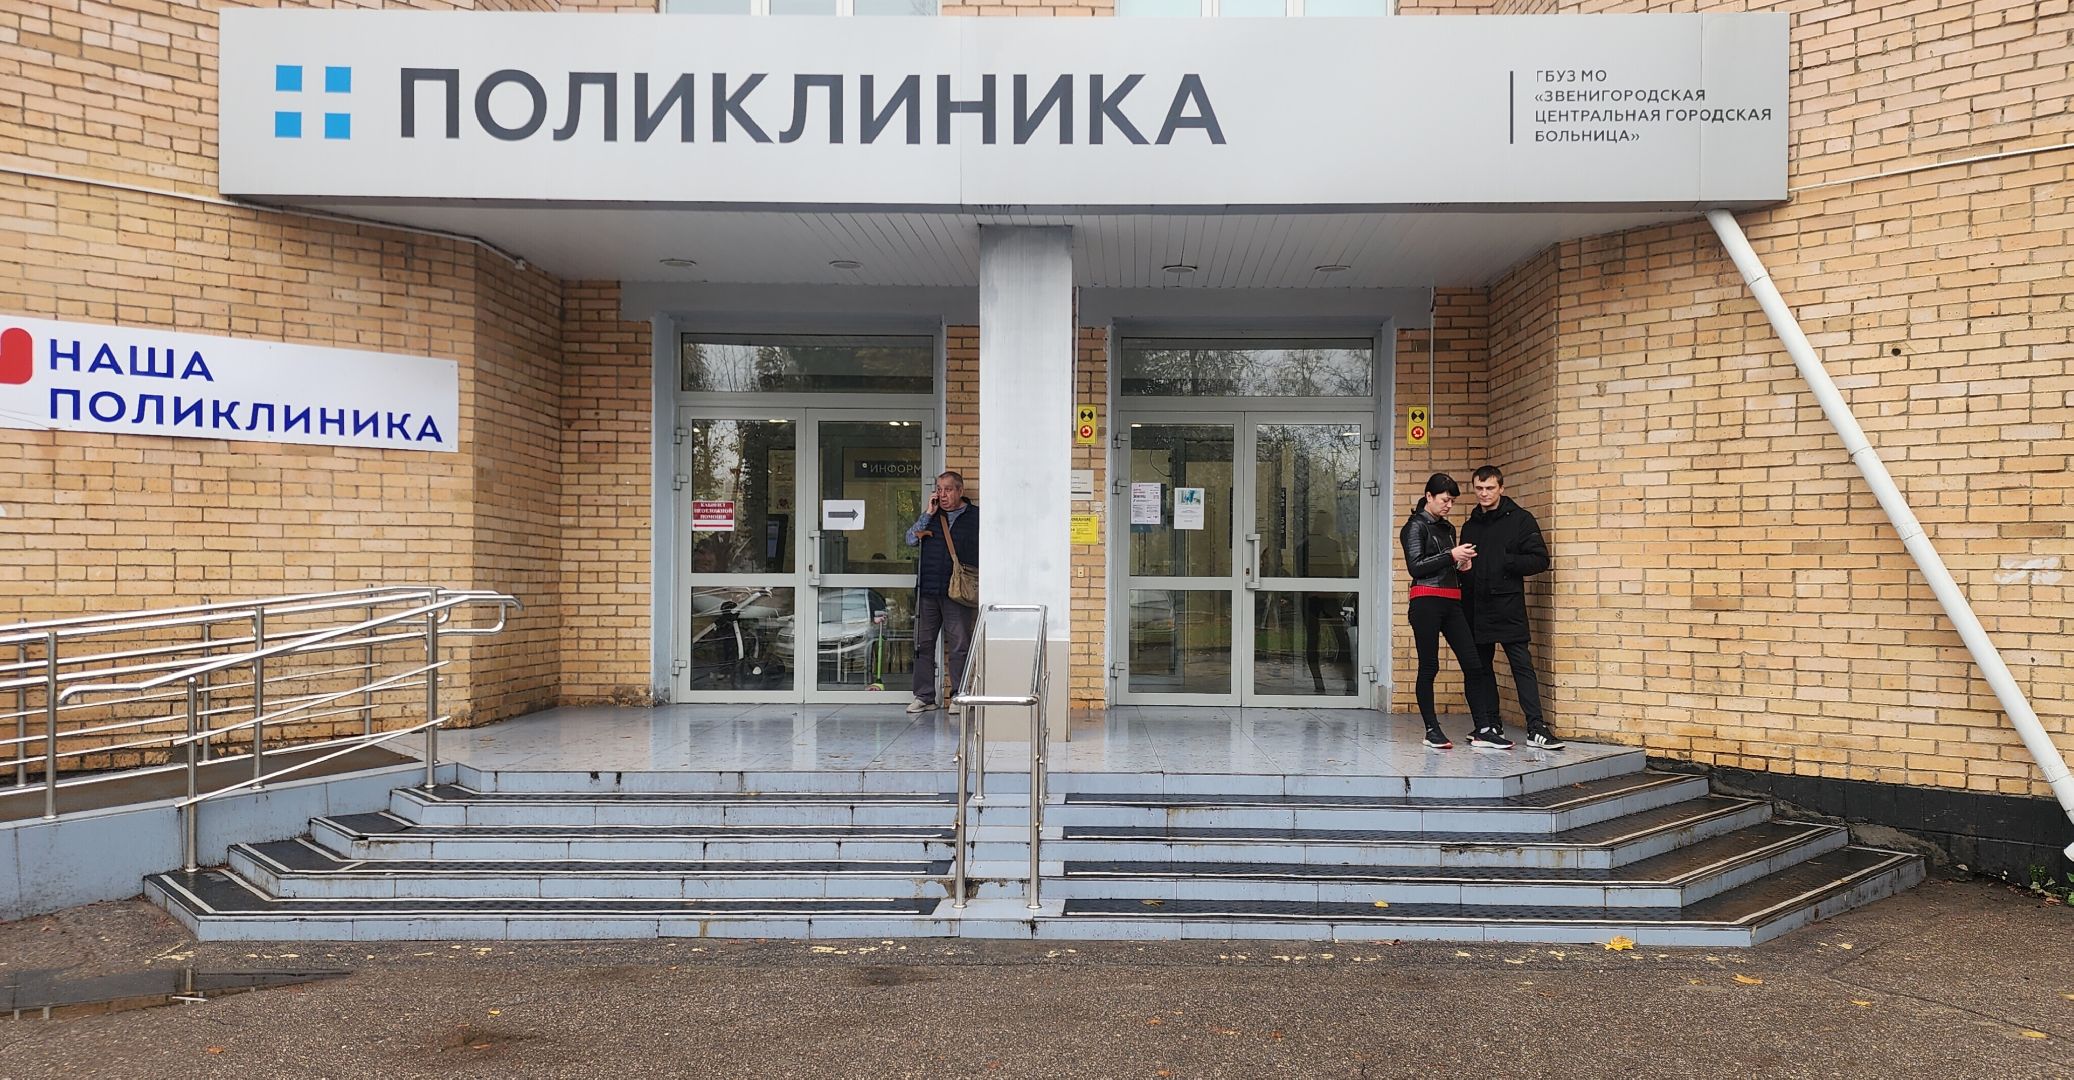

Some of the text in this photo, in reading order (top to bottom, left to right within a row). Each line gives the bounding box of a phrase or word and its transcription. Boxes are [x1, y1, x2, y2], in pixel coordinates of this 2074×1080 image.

[1536, 69, 1608, 83] ГБУЗ МО
[1535, 89, 1706, 104] «ЗВЕНИГОРОДСКАЯ
[401, 68, 1228, 146] ПОЛИКЛИНИКА
[1535, 108, 1772, 124] ЦЕНТРАЛЬНАЯ ГОРОДСКАЯ
[1535, 129, 1640, 144] БОЛЬНИЦА»
[50, 338, 214, 382] НАША
[50, 388, 443, 443] ПОЛИКЛИНИКА
